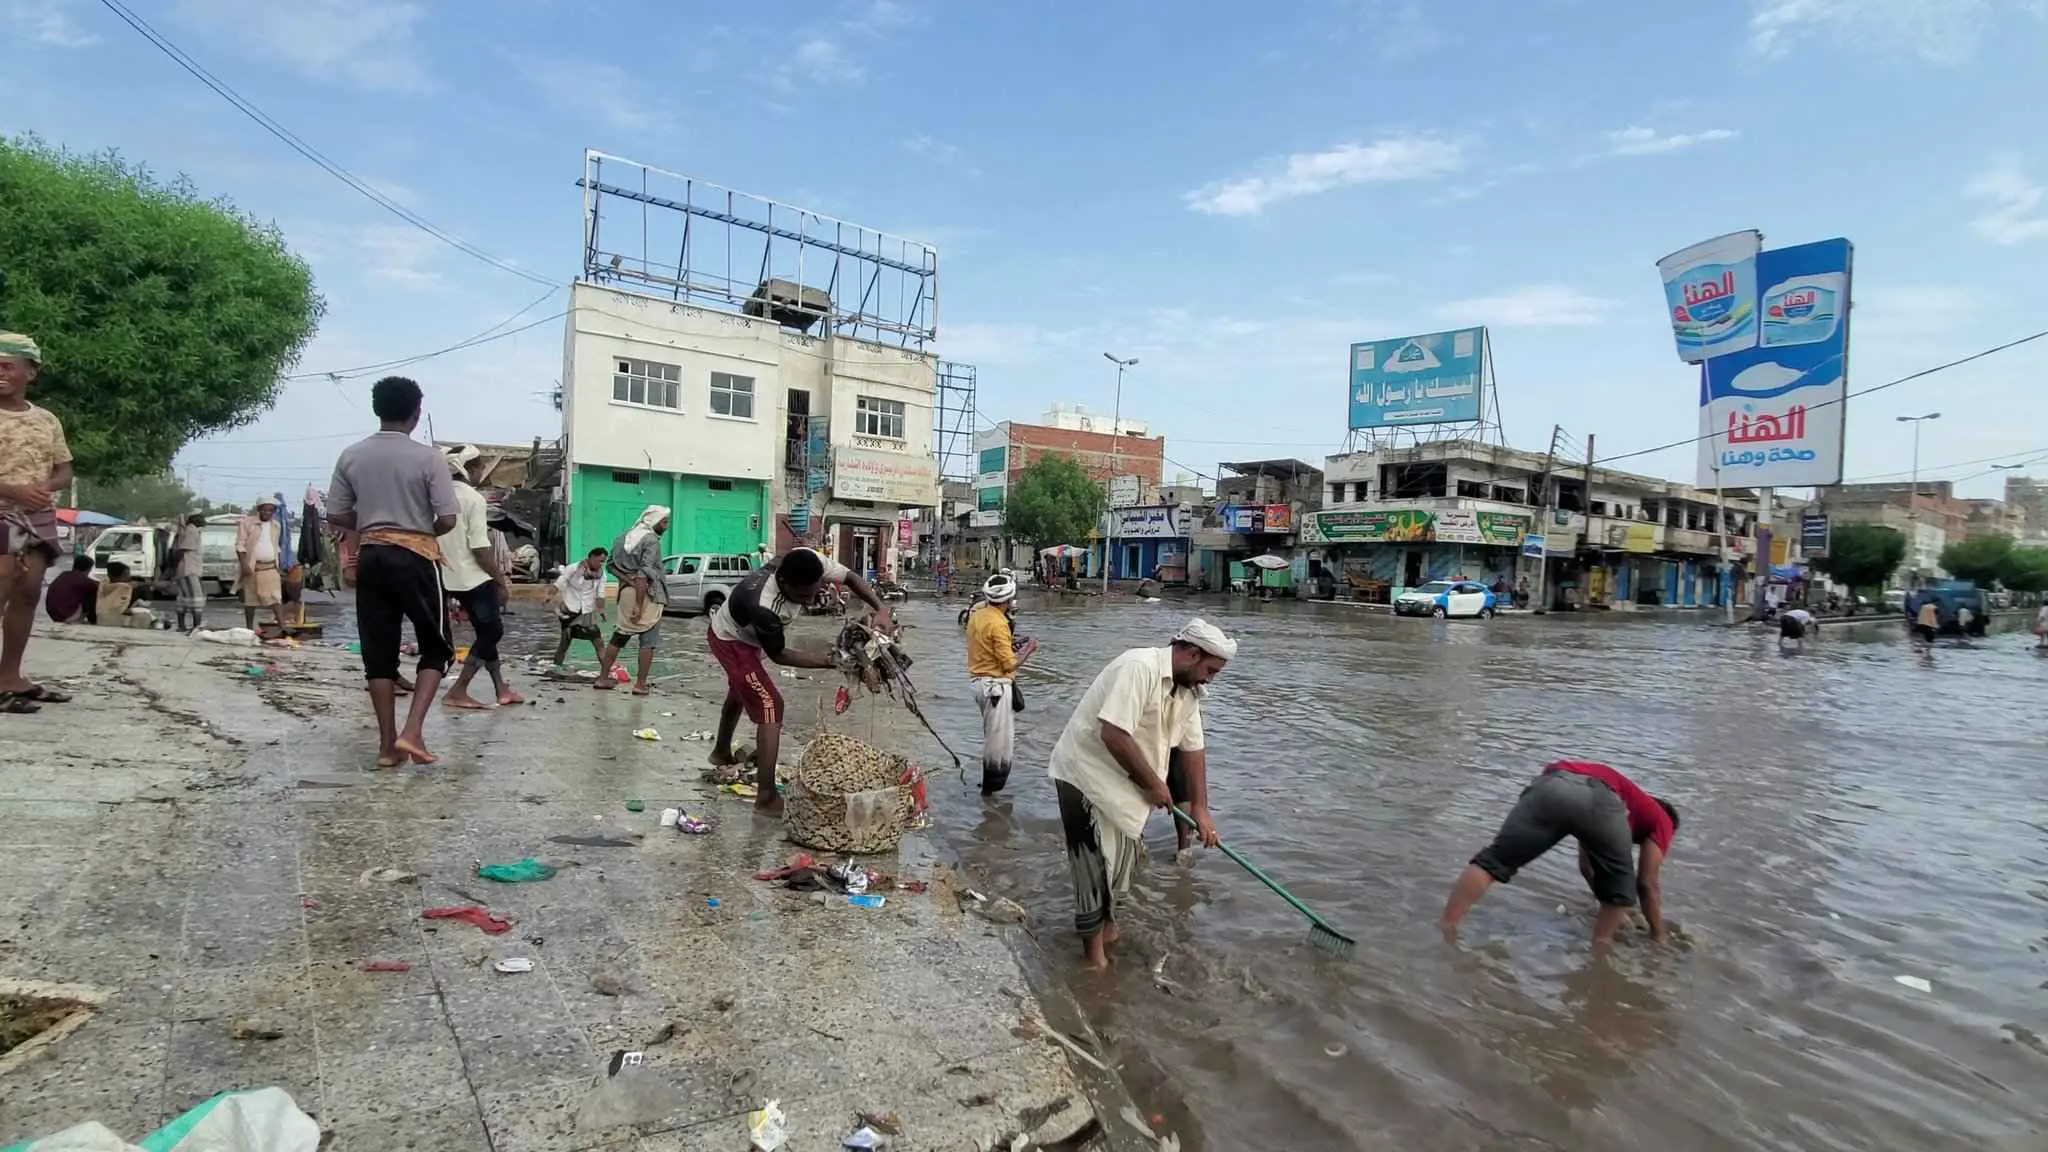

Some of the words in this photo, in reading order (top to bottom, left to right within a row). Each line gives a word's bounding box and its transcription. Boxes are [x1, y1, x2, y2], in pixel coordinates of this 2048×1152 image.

[1685, 271, 1734, 305] الهنا
[1355, 382, 1373, 405] الله
[1376, 380, 1411, 407] رسول
[1414, 378, 1425, 403] يا
[1426, 373, 1473, 400] لبيك
[1727, 404, 1805, 443] الهنا
[1721, 451, 1767, 466] وهنا
[1769, 447, 1815, 461] صحة
